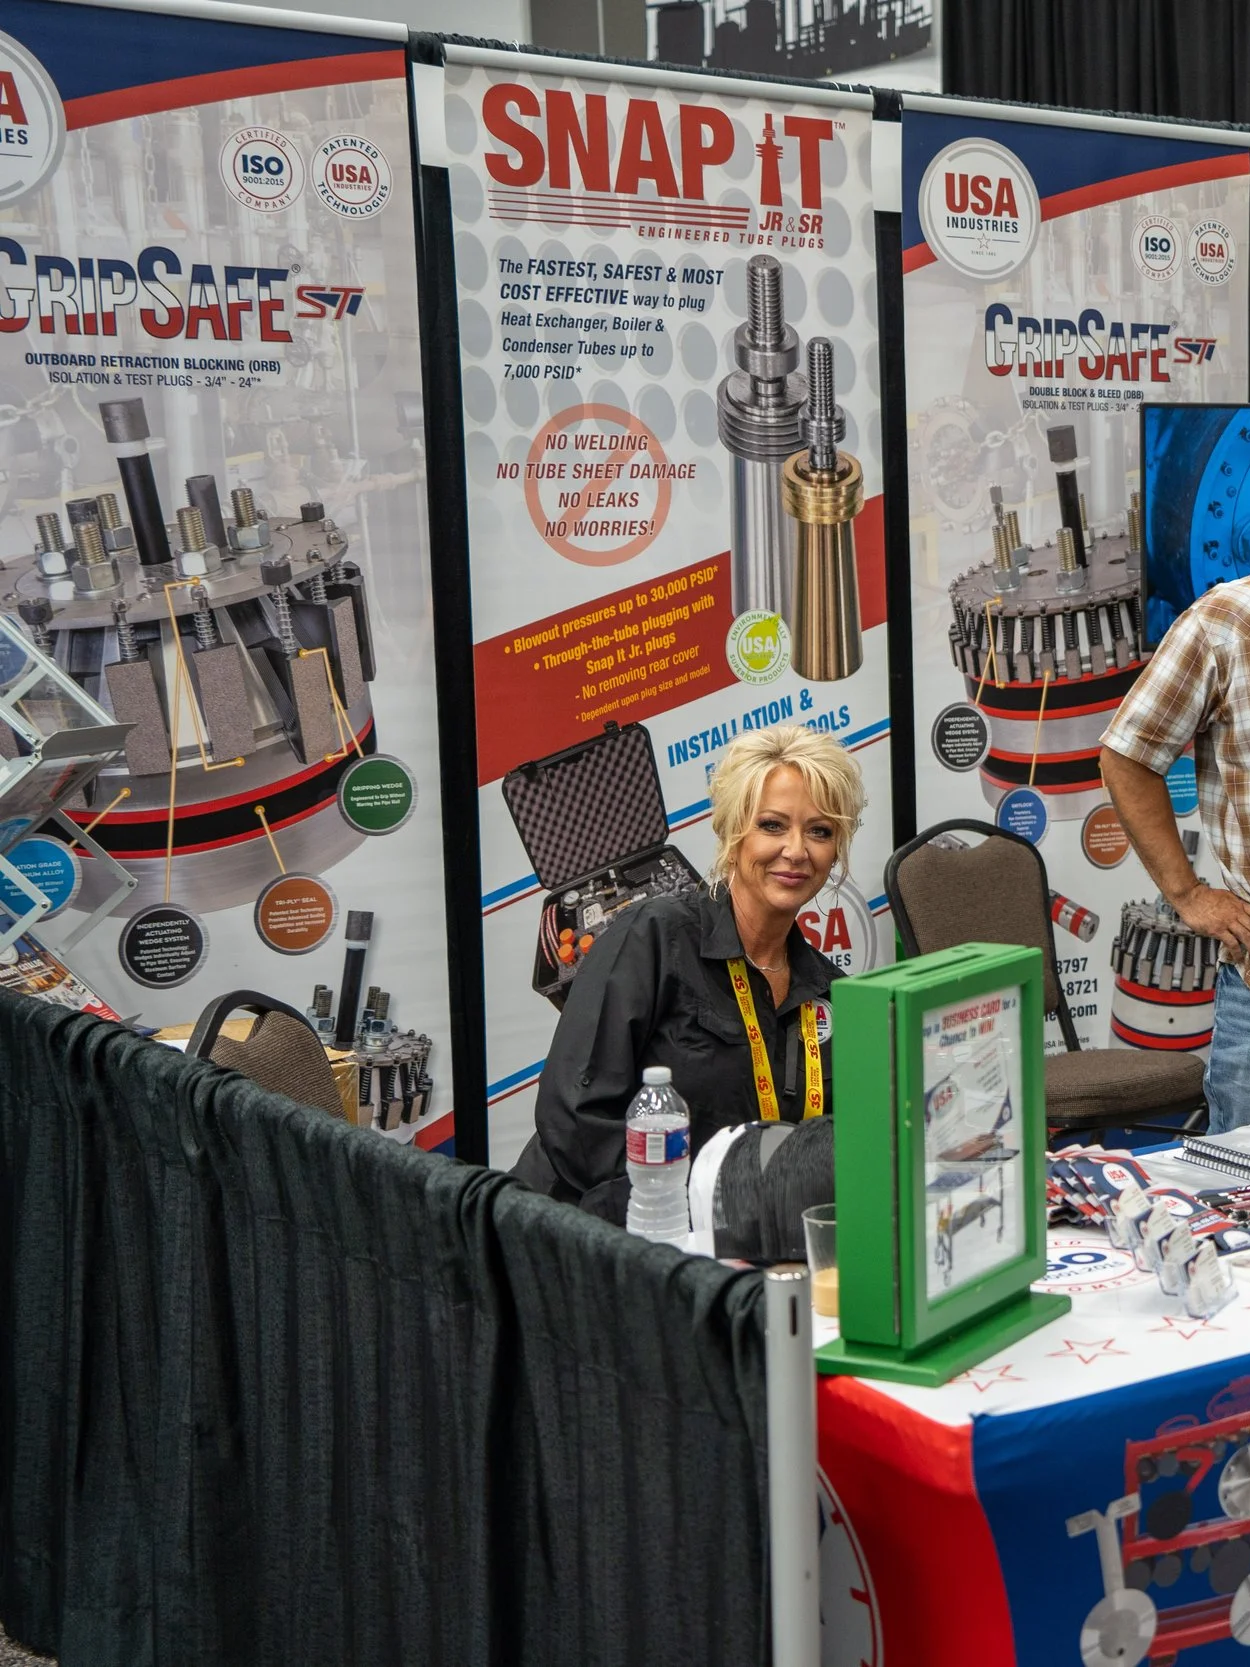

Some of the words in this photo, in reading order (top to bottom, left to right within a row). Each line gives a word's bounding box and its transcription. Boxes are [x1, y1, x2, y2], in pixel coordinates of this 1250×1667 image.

[235, 130, 287, 149] CERTIFIED
[322, 138, 378, 160] PATENTED
[481, 83, 736, 200] SNAP
[241, 154, 284, 176] ISO
[331, 163, 372, 184] USA
[242, 176, 285, 186] 9001:2015
[238, 190, 292, 209] COMPANY
[317, 181, 388, 215] TECHNOLOGIES
[945, 172, 1019, 219] USA
[759, 211, 784, 232] JR
[786, 216, 796, 233] &
[798, 214, 824, 235] SR
[946, 216, 1018, 233] INDUSTRIES
[1194, 222, 1230, 239] PATENTED
[638, 225, 732, 244] ENGINEERED
[739, 232, 775, 246] TUBE
[781, 236, 825, 250] PLUGS
[1144, 236, 1171, 253] ISO
[1200, 242, 1225, 258] USA
[499, 259, 522, 274] The
[527, 259, 598, 281] FASTEST,
[603, 263, 662, 282] SAFEST
[667, 267, 677, 283] &
[682, 268, 724, 286] MOST
[499, 284, 541, 302] COST
[545, 286, 628, 306] EFFECTIVE
[632, 294, 659, 310] way
[663, 294, 674, 307] to
[679, 294, 706, 312] plug
[501, 311, 532, 327] Heat
[535, 312, 608, 333] Exchanger,
[612, 316, 652, 332] Boiler
[654, 317, 665, 332] &
[502, 337, 574, 355] Condenser
[577, 340, 617, 356] Tubes
[620, 345, 637, 361] up
[642, 343, 654, 357] to
[25, 353, 96, 367] OUTBOARD
[101, 356, 179, 370] RETRACTION
[184, 358, 244, 371] BLOCKING
[249, 359, 281, 374] (ORB)
[503, 364, 540, 382] 7,000
[49, 371, 110, 384] ISOLATION
[113, 374, 122, 385] &
[125, 374, 152, 385] TEST
[157, 375, 193, 387] PLUGS
[1029, 386, 1060, 397] DOUBLE
[1062, 387, 1087, 398] BLOCK
[1089, 388, 1095, 398] &
[1098, 389, 1121, 399] BLEED
[1123, 390, 1144, 401] (DBB)
[1022, 400, 1059, 410] ISOLATION
[1068, 401, 1085, 411] TEST
[1086, 402, 1109, 411] PLUGS
[545, 434, 569, 451] NO
[574, 433, 648, 451] WELDING
[496, 464, 520, 479] NO
[524, 464, 568, 479] TUBE
[572, 463, 624, 480] SHEET
[629, 463, 696, 480] DAMAGE
[558, 492, 581, 509] NO
[586, 491, 639, 508] LEAKS
[544, 521, 568, 537] NO
[573, 520, 655, 537] WORRIES!
[513, 624, 561, 654] Blowout
[562, 604, 617, 638] pressures
[619, 600, 634, 618] up
[636, 594, 648, 608] to
[650, 577, 688, 603] 30,000
[542, 624, 640, 670] Through-the-tube
[642, 606, 690, 636] plugging
[691, 594, 715, 613] with
[585, 655, 615, 675] Snap
[617, 649, 626, 663] It
[628, 643, 643, 659] Jr.
[645, 631, 677, 655] plugs
[742, 636, 775, 654] USA
[582, 684, 597, 700] No
[598, 666, 647, 692] removing
[649, 657, 670, 674] rear
[673, 645, 700, 665] cover
[760, 652, 789, 683] PRODUCTS
[581, 701, 620, 722] Dependent
[621, 694, 639, 707] upon
[640, 686, 658, 700] plug
[658, 681, 673, 692] size
[674, 674, 688, 687] and
[689, 664, 711, 680] model
[668, 695, 793, 768] INSTALLATION
[800, 688, 813, 711] &
